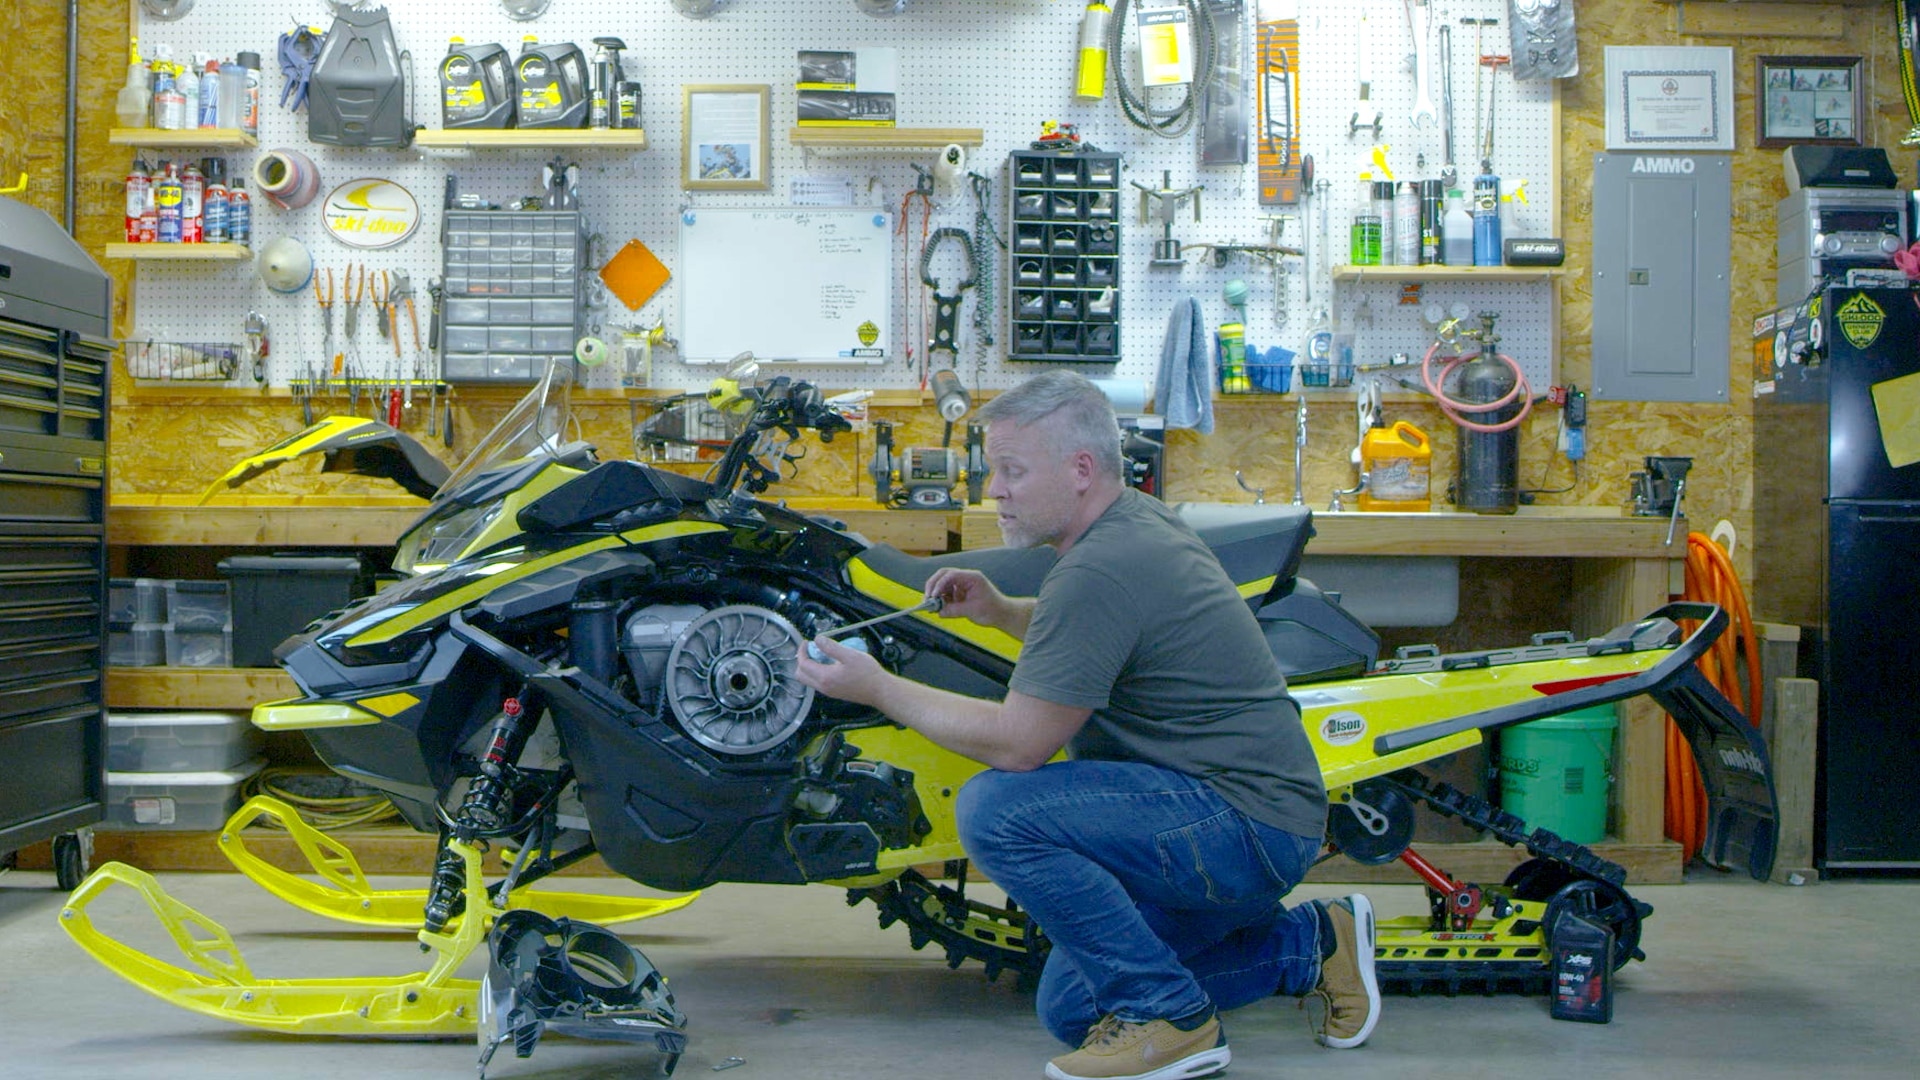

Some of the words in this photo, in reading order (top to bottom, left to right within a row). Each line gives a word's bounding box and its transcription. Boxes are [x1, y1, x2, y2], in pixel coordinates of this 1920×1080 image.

[1632, 157, 1695, 174] AMMO
[332, 215, 407, 234] ski-doo
[1515, 244, 1557, 254] ski-doo
[853, 348, 881, 357] AMMO
